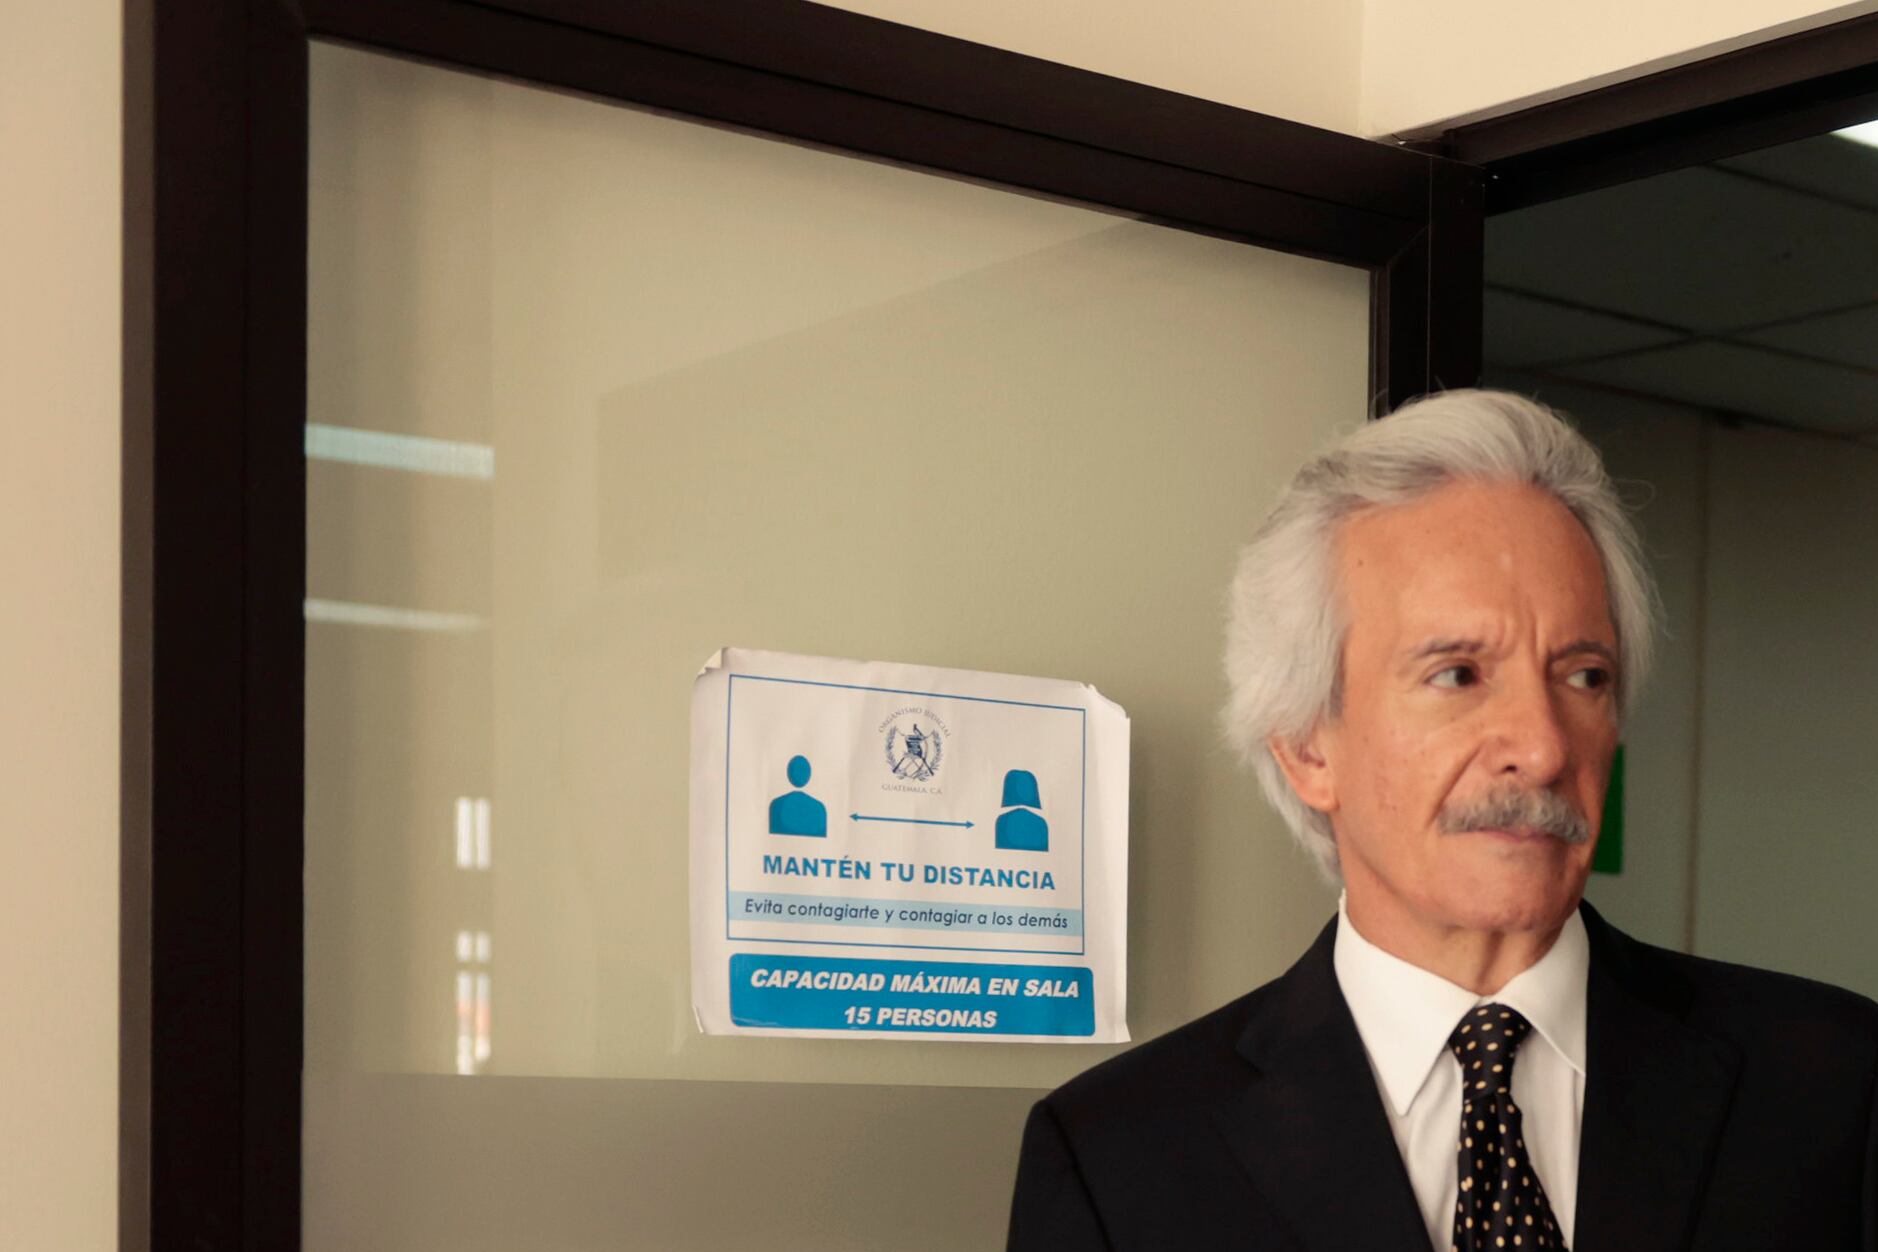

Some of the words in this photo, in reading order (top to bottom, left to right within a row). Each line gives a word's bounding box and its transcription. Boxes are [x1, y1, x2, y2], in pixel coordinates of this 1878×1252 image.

[763, 854, 871, 880] MANTÉN
[880, 862, 915, 882] TU
[923, 864, 1056, 890] DISTANCIA
[745, 898, 783, 915] Evita
[787, 902, 880, 921] contagiarte
[884, 909, 894, 923] y
[898, 908, 973, 926] contagiar
[977, 914, 987, 925] a
[992, 911, 1013, 926] los
[1018, 913, 1068, 929] demás
[751, 968, 886, 992] CAPACIDAD
[889, 971, 981, 995] MÁXIMA
[987, 978, 1020, 996] EN
[1023, 979, 1080, 998] SALA
[844, 1005, 872, 1025] 15
[876, 1007, 998, 1029] PERSONAS
